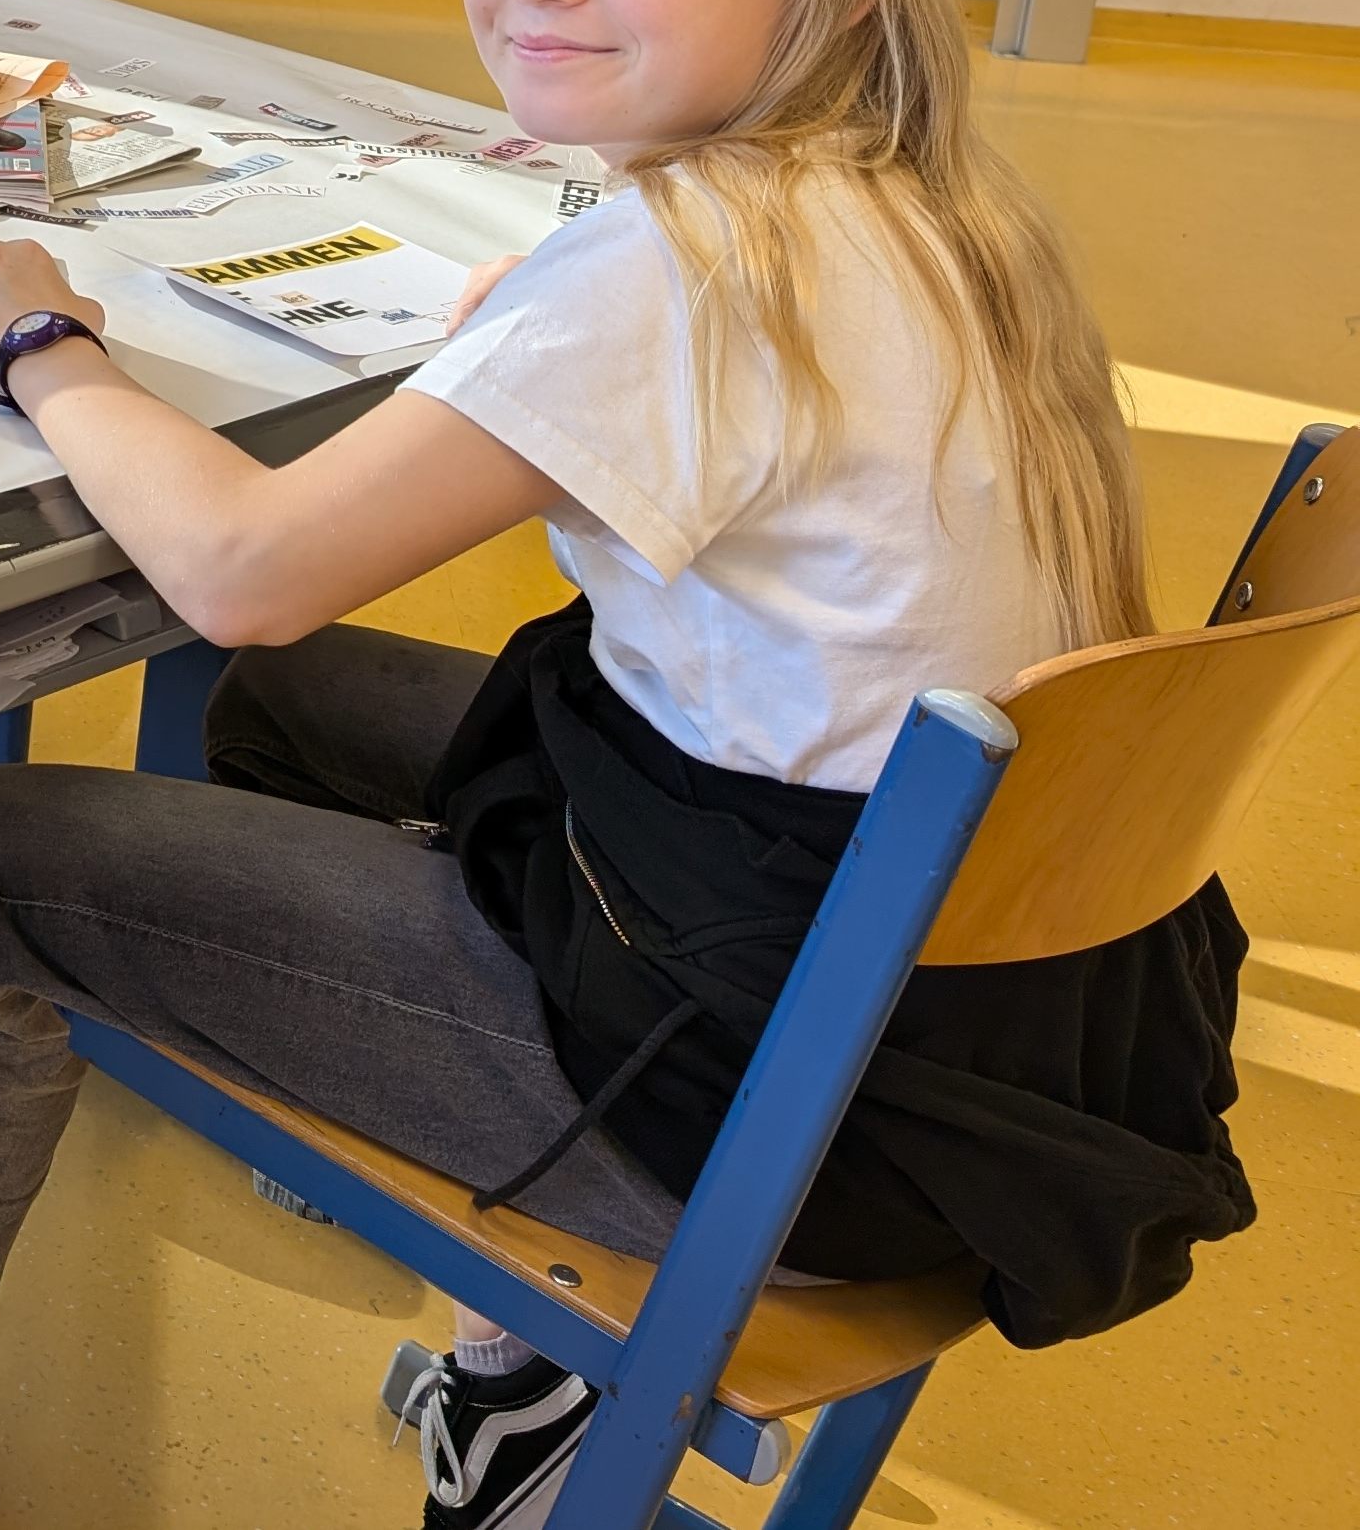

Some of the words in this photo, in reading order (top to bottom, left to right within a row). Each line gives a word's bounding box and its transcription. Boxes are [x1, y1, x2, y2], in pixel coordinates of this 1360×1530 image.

[353, 142, 479, 161] Politische
[482, 137, 538, 162] MEIN
[206, 153, 286, 183] HALLO
[187, 183, 323, 213] ERNTEDANK
[73, 206, 194, 219] Besitzer:innen
[281, 291, 308, 304] der
